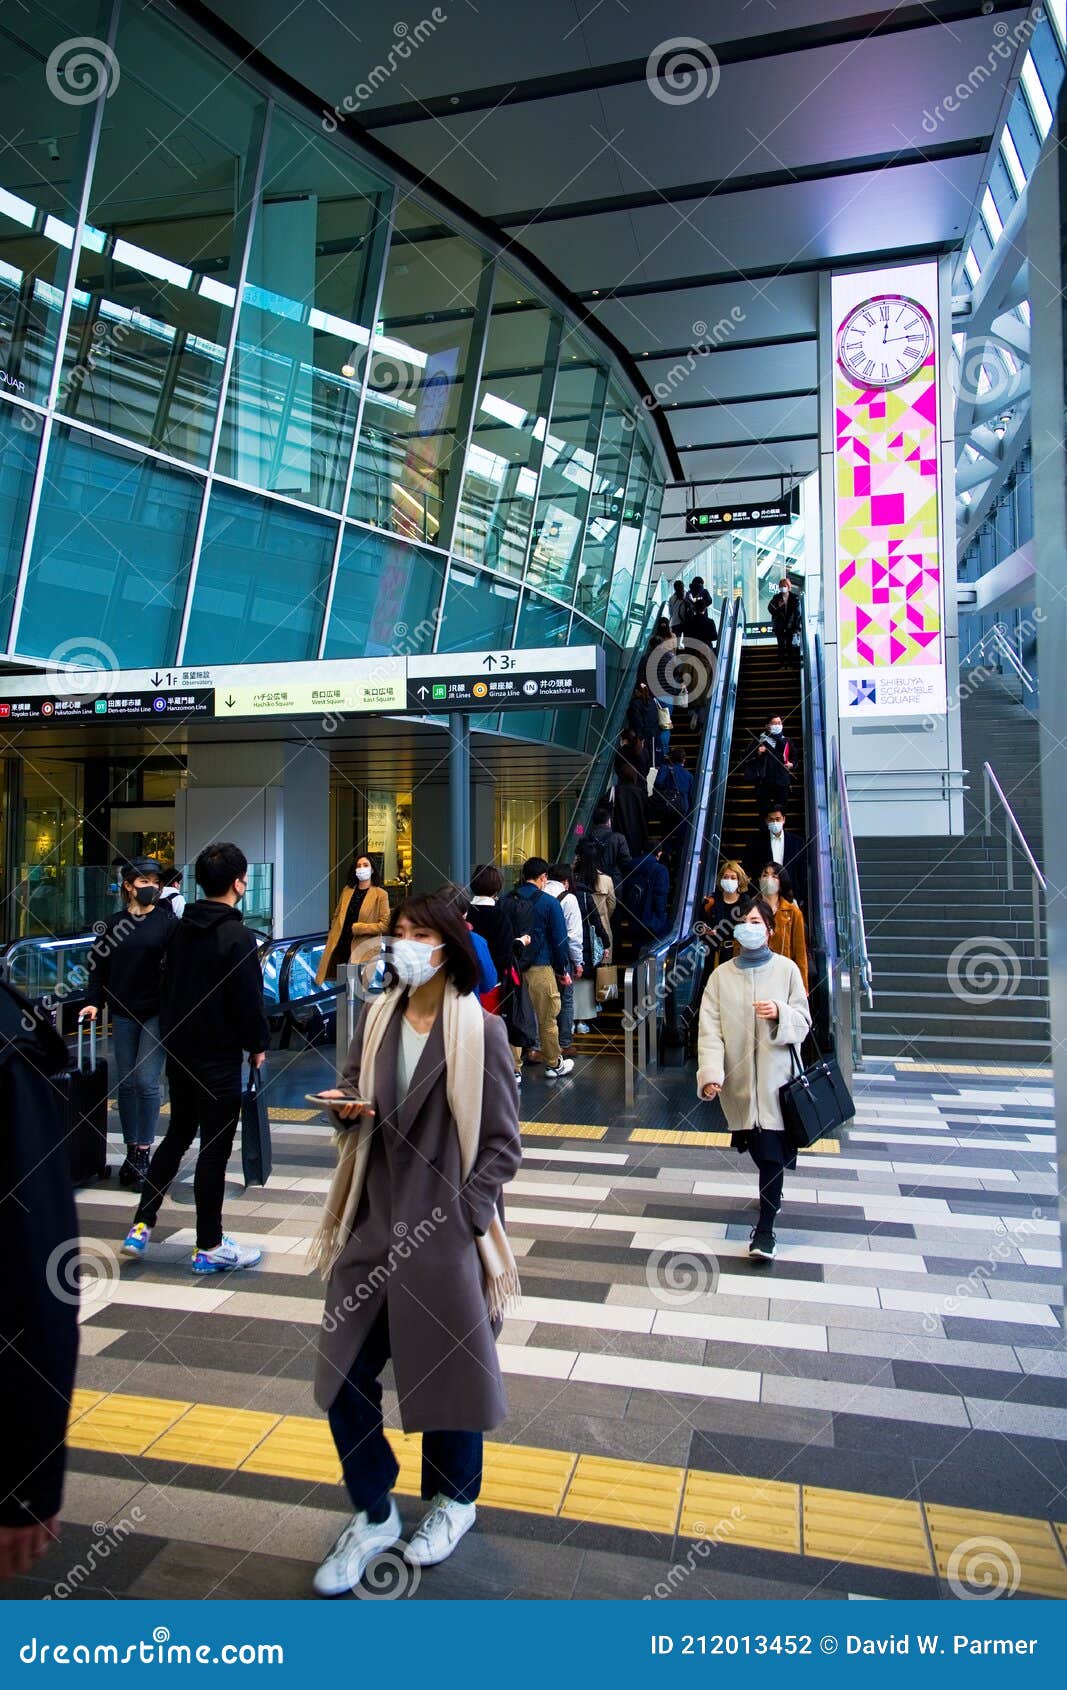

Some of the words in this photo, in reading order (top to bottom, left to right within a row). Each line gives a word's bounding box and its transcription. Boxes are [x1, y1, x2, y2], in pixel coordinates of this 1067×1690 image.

[500, 655, 516, 670] 3F
[166, 672, 178, 686] 1F
[880, 678, 923, 687] SHIBUYA
[434, 688, 444, 696] JR
[448, 684, 465, 692] JR線
[880, 695, 921, 705] SQUARE
